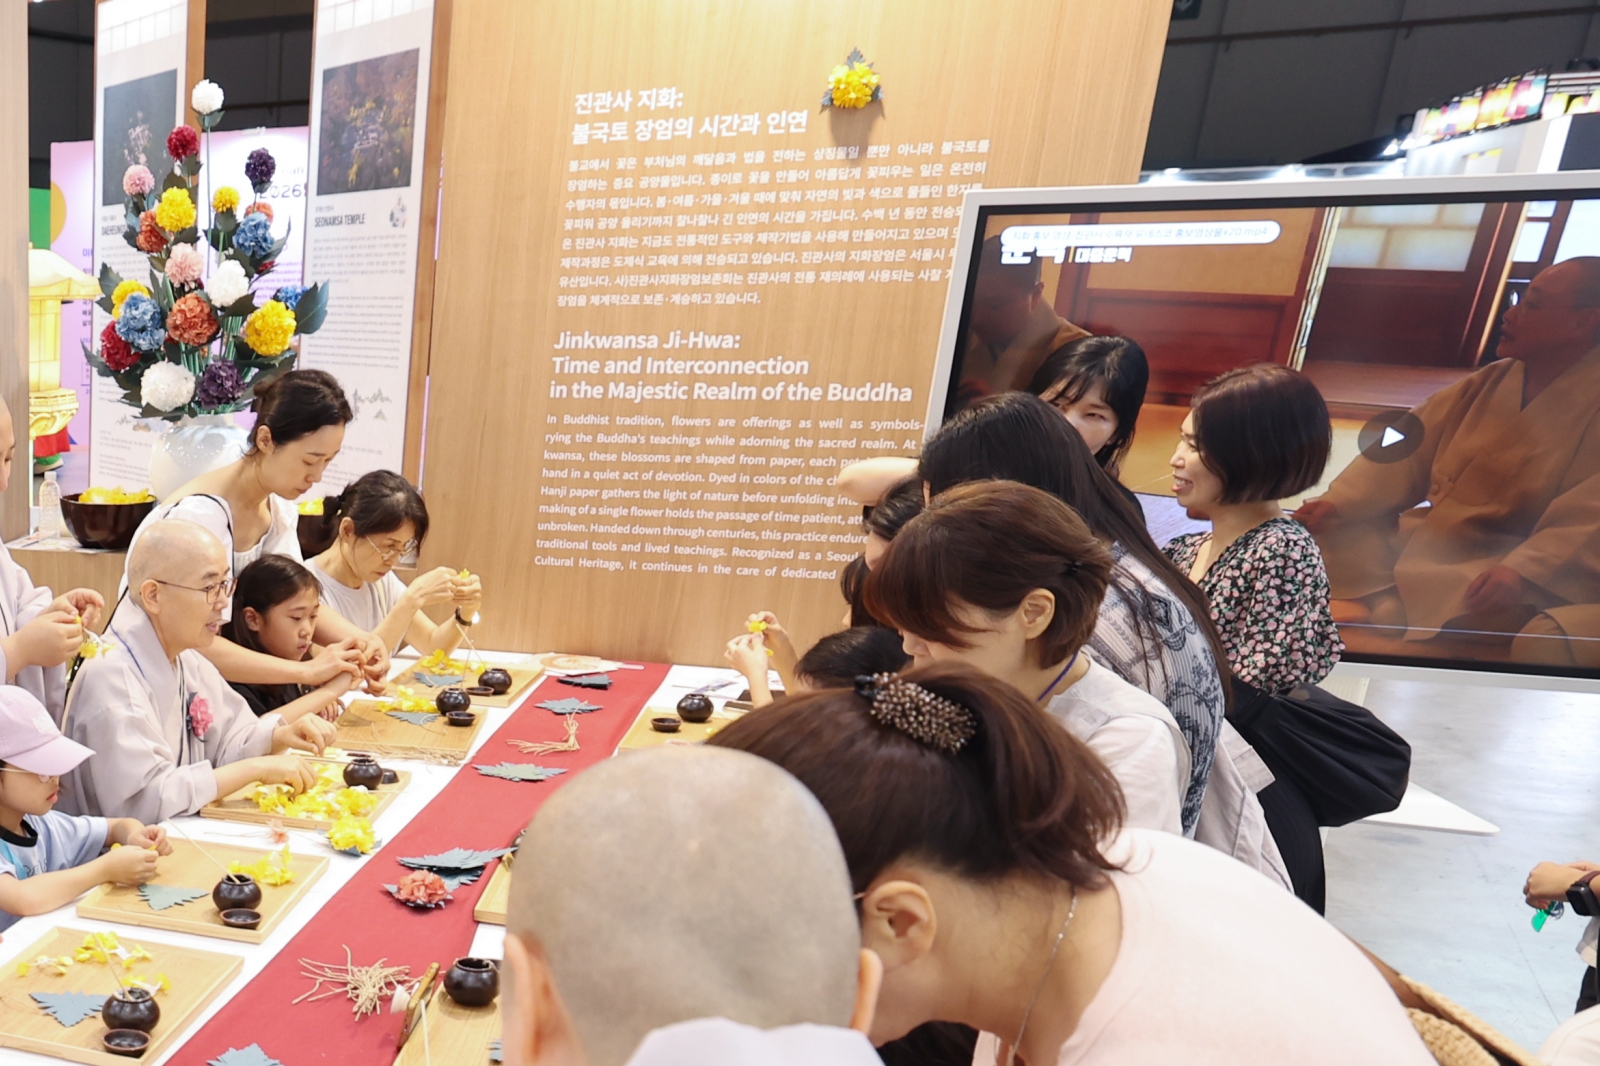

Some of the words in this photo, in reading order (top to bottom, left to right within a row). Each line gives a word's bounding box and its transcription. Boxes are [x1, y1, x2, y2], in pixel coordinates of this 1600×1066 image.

[575, 90, 632, 114] 진관사
[638, 87, 684, 109] 지화:
[572, 122, 628, 145] 불국토
[635, 117, 694, 141] 장엄의
[700, 113, 761, 137] 시간과
[767, 110, 808, 134] 인연
[568, 158, 610, 172] 불교에서
[616, 157, 637, 170] 꽃은
[644, 154, 687, 168] 부처님의
[693, 152, 737, 166] 깨달음과
[743, 150, 766, 164] 법을
[773, 149, 806, 163] 전하는
[814, 146, 859, 161] 상징물일
[867, 144, 891, 158] 뿐만
[897, 142, 934, 156] 아니라
[941, 139, 990, 155] 불국토를
[567, 179, 608, 192] 장엄하는
[613, 177, 634, 190] 중요
[639, 174, 705, 188] 공양물입니다.
[710, 172, 743, 186] 종이로
[748, 171, 771, 184] 꽃을
[776, 169, 810, 183] 만들어
[815, 167, 861, 181] 아름답게
[867, 165, 914, 179] 꽃피우는
[920, 163, 944, 177] 일은
[950, 161, 987, 176] 온전히
[345, 213, 366, 225] TEMPLE
[554, 332, 658, 349] Jinkwansa
[663, 331, 740, 349] Ji-Hwa:
[552, 356, 600, 374] Time
[604, 356, 642, 374] and
[647, 355, 809, 374] Interconnection
[549, 380, 568, 398] in
[572, 381, 604, 399] the
[608, 381, 688, 402] Majestic
[693, 382, 757, 400] Realm
[761, 382, 785, 400] of
[787, 382, 823, 401] the
[828, 383, 912, 401] Buddha
[546, 414, 557, 424] In
[563, 414, 610, 425] Buddhist
[616, 415, 664, 427] tradition,
[671, 415, 711, 426] flowers
[717, 418, 736, 427] are
[742, 416, 792, 430] offerings
[798, 419, 812, 428] as
[819, 418, 844, 429] well
[849, 420, 864, 429] as
[545, 432, 572, 445] rying
[575, 432, 593, 443] the
[597, 433, 646, 444] Buddha's
[650, 434, 701, 447] teachings
[705, 435, 735, 446] while
[739, 436, 790, 449] adorning
[795, 436, 814, 448] the
[818, 438, 857, 448] sacred
[861, 438, 898, 449] realm.
[902, 438, 916, 450] At
[543, 450, 585, 462] kwansa,
[589, 451, 618, 461] these
[621, 452, 671, 462] blossoms
[674, 455, 692, 463] are
[696, 454, 736, 466] shaped
[739, 454, 766, 465] from
[769, 457, 805, 468] paper,
[809, 456, 836, 467] each
[542, 468, 568, 478] hand
[570, 468, 581, 479] in
[583, 470, 591, 479] a
[592, 469, 620, 481] quiet
[622, 471, 639, 480] act
[641, 470, 654, 480] of
[655, 471, 705, 482] devotion.
[708, 472, 737, 485] Dyed
[739, 473, 750, 483] in
[753, 474, 787, 484] colors
[789, 474, 803, 485] of
[804, 475, 824, 486] the
[540, 486, 567, 498] Hanji
[569, 488, 600, 498] paper
[601, 488, 640, 500] gathers
[643, 489, 661, 499] the
[663, 489, 687, 502] light
[689, 490, 702, 500] of
[703, 492, 739, 502] nature
[742, 492, 778, 503] before
[780, 493, 835, 507] unfolding
[536, 539, 588, 550] traditional
[592, 541, 617, 551] tools
[621, 542, 642, 552] and
[644, 542, 670, 553] lived
[674, 545, 727, 558] teachings.
[732, 547, 794, 560] Recognized
[797, 551, 811, 560] as
[814, 552, 822, 561] a
[534, 555, 574, 566] Cultural
[579, 558, 624, 571] Heritage,
[629, 559, 638, 570] it
[642, 562, 693, 572] continues
[697, 563, 709, 573] in
[713, 564, 732, 574] the
[736, 567, 760, 576] care
[764, 566, 777, 577] of
[781, 568, 837, 580] dedicated
